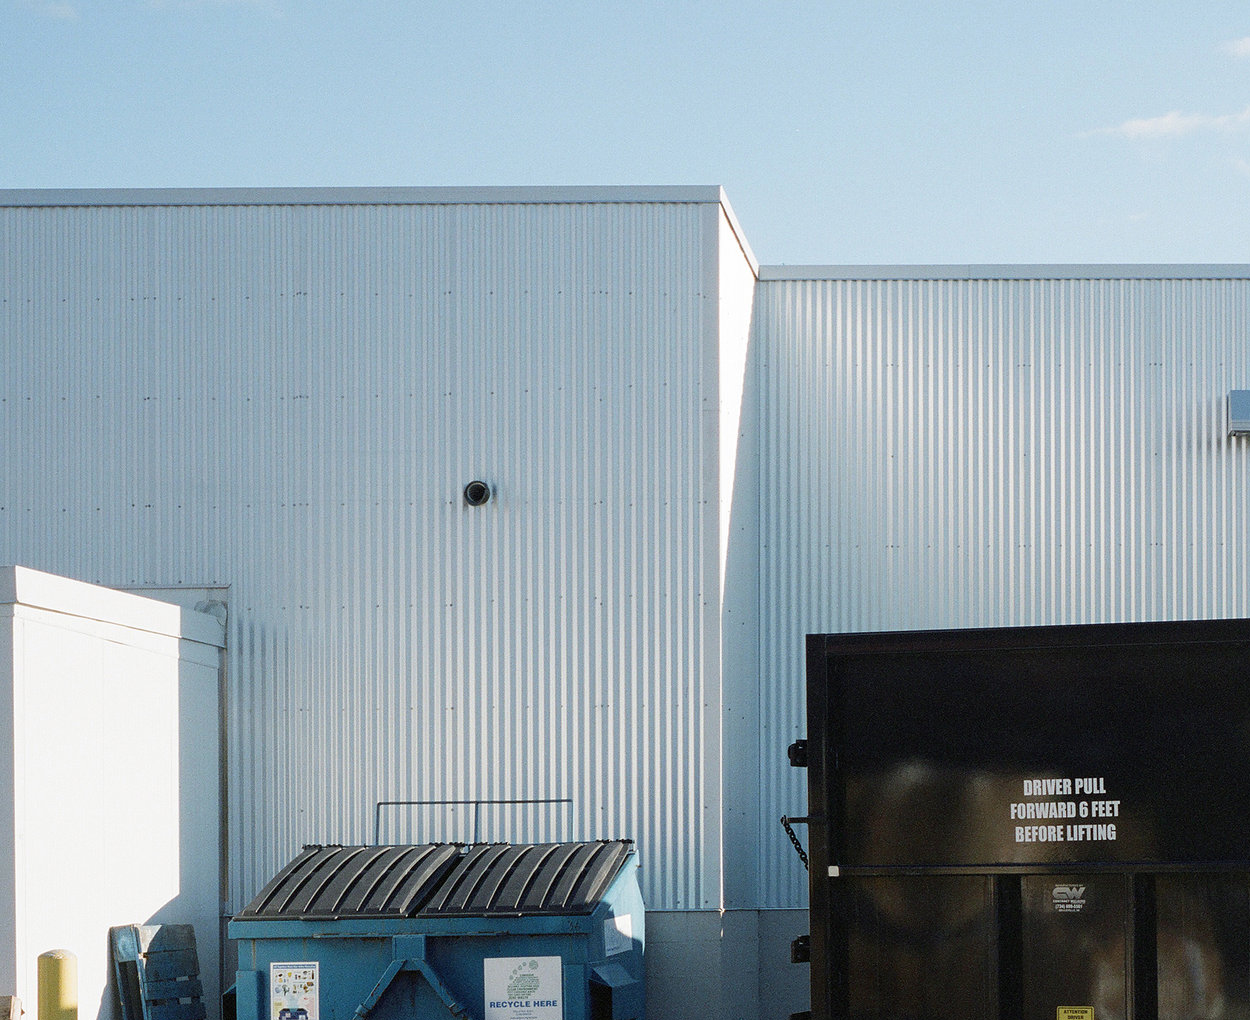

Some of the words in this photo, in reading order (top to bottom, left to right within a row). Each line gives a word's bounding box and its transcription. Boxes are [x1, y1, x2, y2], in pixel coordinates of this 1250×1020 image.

[1023, 778, 1072, 796] DRIVER
[1074, 777, 1107, 795] PULL
[1010, 801, 1077, 819] FORWARD
[1079, 801, 1089, 818] 6
[1091, 800, 1121, 817] FEET
[1015, 825, 1064, 843] BEFORE
[1066, 823, 1117, 841] LIFTING
[489, 1000, 531, 1008] RECYCLE
